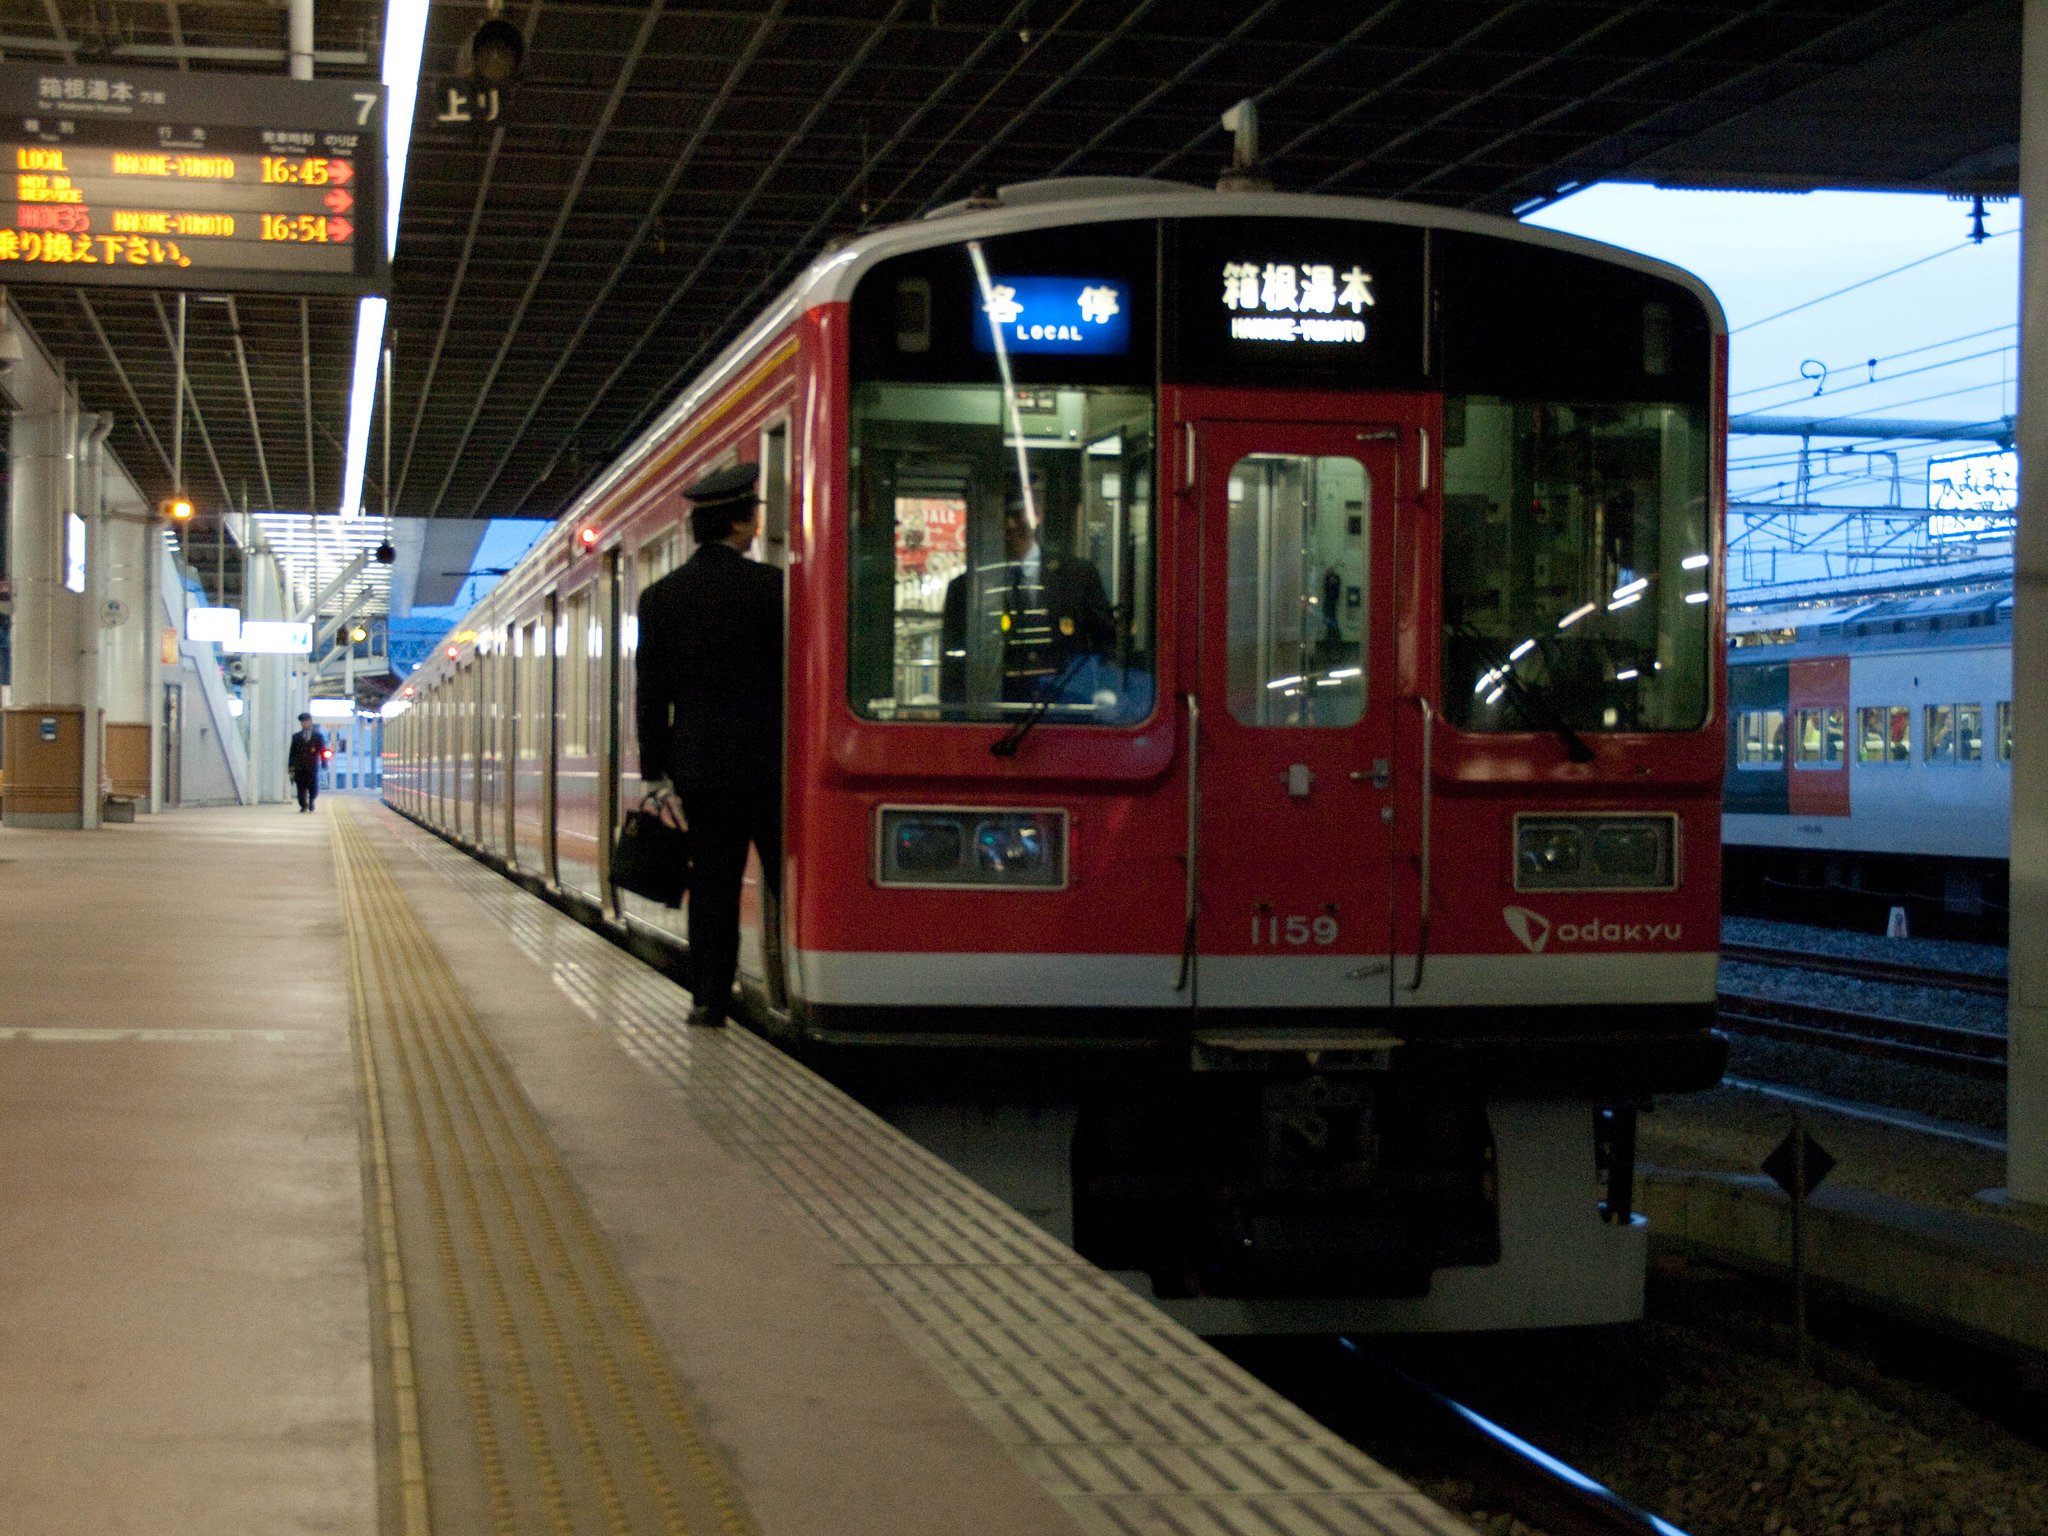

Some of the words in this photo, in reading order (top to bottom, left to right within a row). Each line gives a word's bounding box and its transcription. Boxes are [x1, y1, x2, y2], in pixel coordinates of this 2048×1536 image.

[38, 78, 134, 101] 箱根湯本
[437, 88, 499, 122] 上り
[352, 93, 377, 125] 7
[17, 147, 68, 172] LOCAL
[112, 152, 235, 179] HAKONE-YUMOTO
[260, 156, 329, 185] 16:45
[17, 174, 49, 189] NOT
[18, 188, 83, 203] SERVICE
[112, 209, 235, 236] HAKONE-YUMOTO
[260, 213, 329, 242] 16:54
[1222, 262, 1375, 314] 箱根湯本
[1016, 325, 1084, 341] LOCAL
[1250, 914, 1340, 947] 1159
[1556, 920, 1683, 943] odakyu
